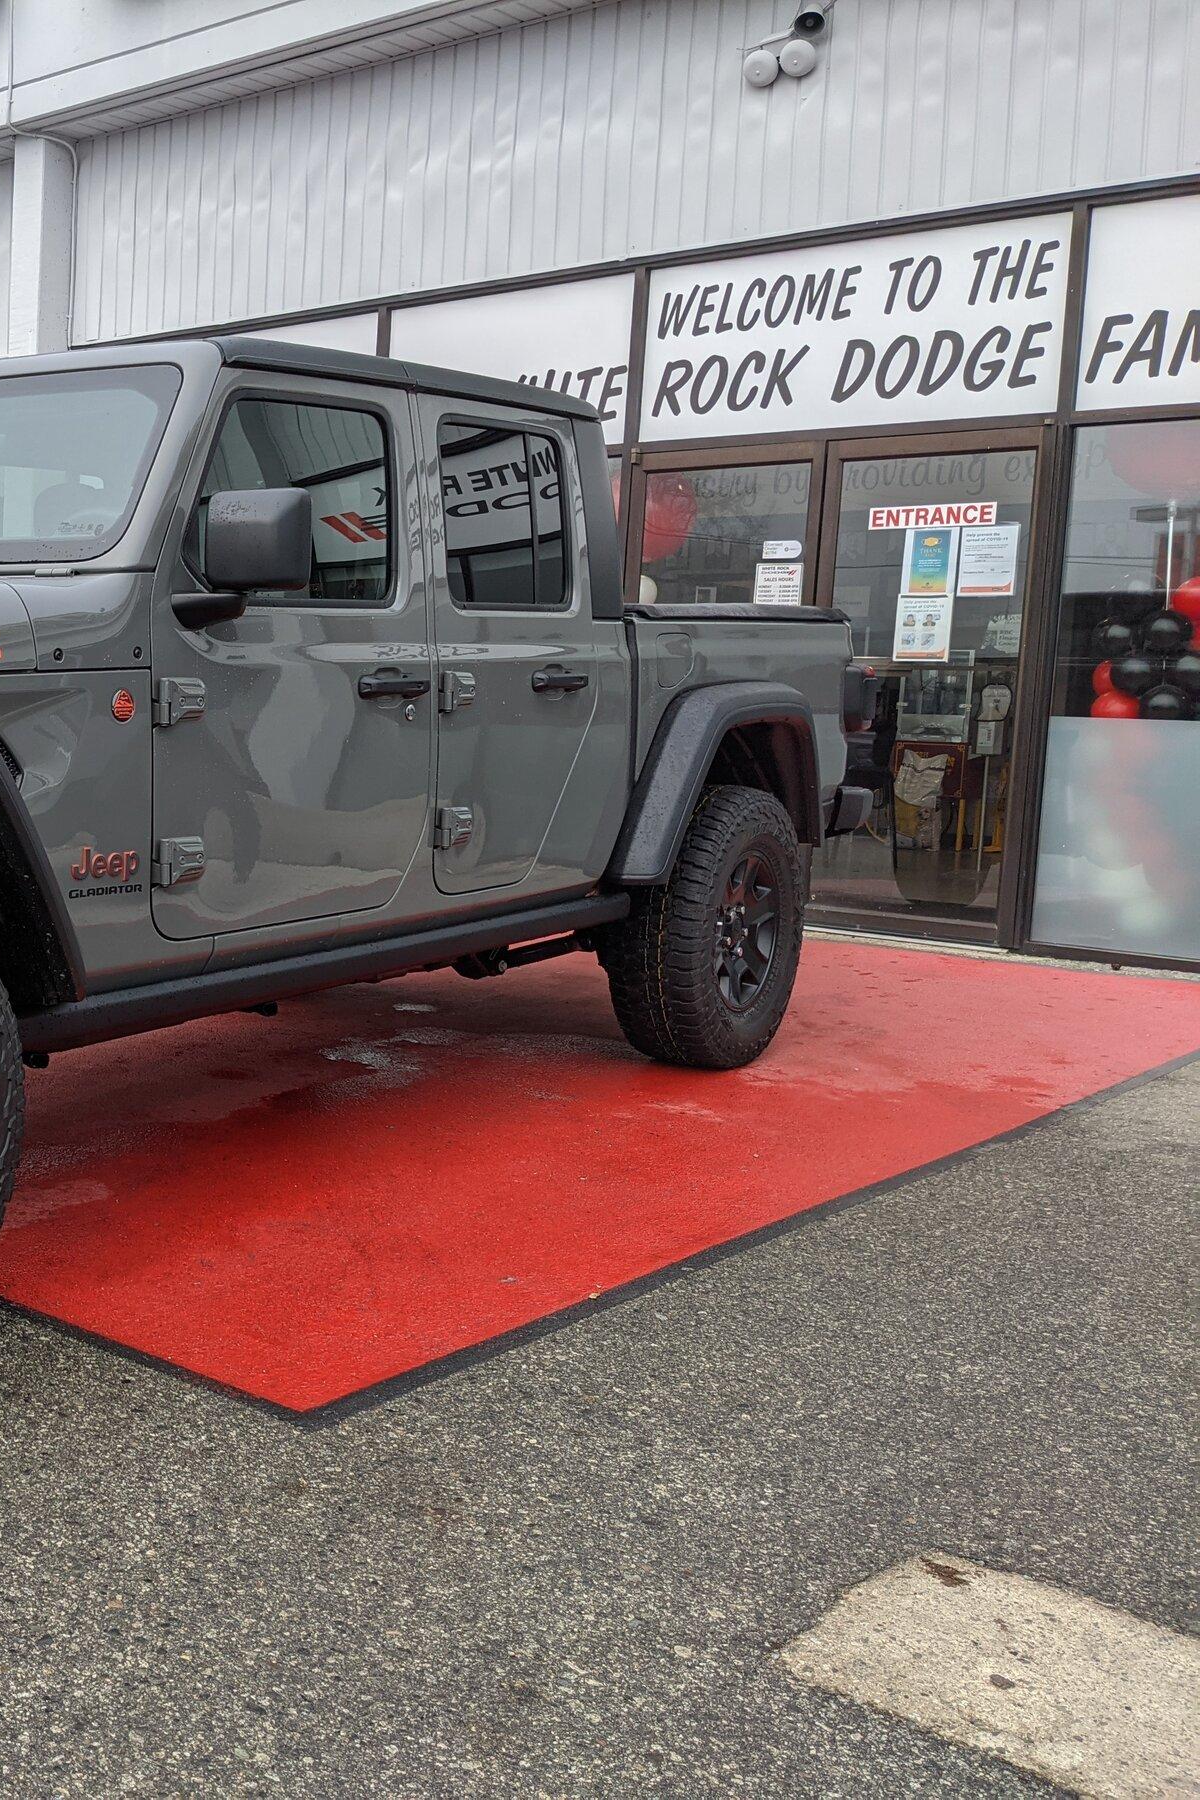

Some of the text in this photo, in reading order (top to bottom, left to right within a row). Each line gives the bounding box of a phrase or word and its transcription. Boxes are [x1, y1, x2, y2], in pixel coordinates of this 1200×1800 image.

[657, 239, 1061, 340] WELCOME TO THE
[651, 344, 810, 418] ROCK
[831, 321, 1053, 403] DODGE
[845, 452, 986, 496] roviding
[872, 504, 994, 527] ENTRANCE
[70, 847, 140, 882] Jeep
[68, 884, 143, 899] GLADIATOR
